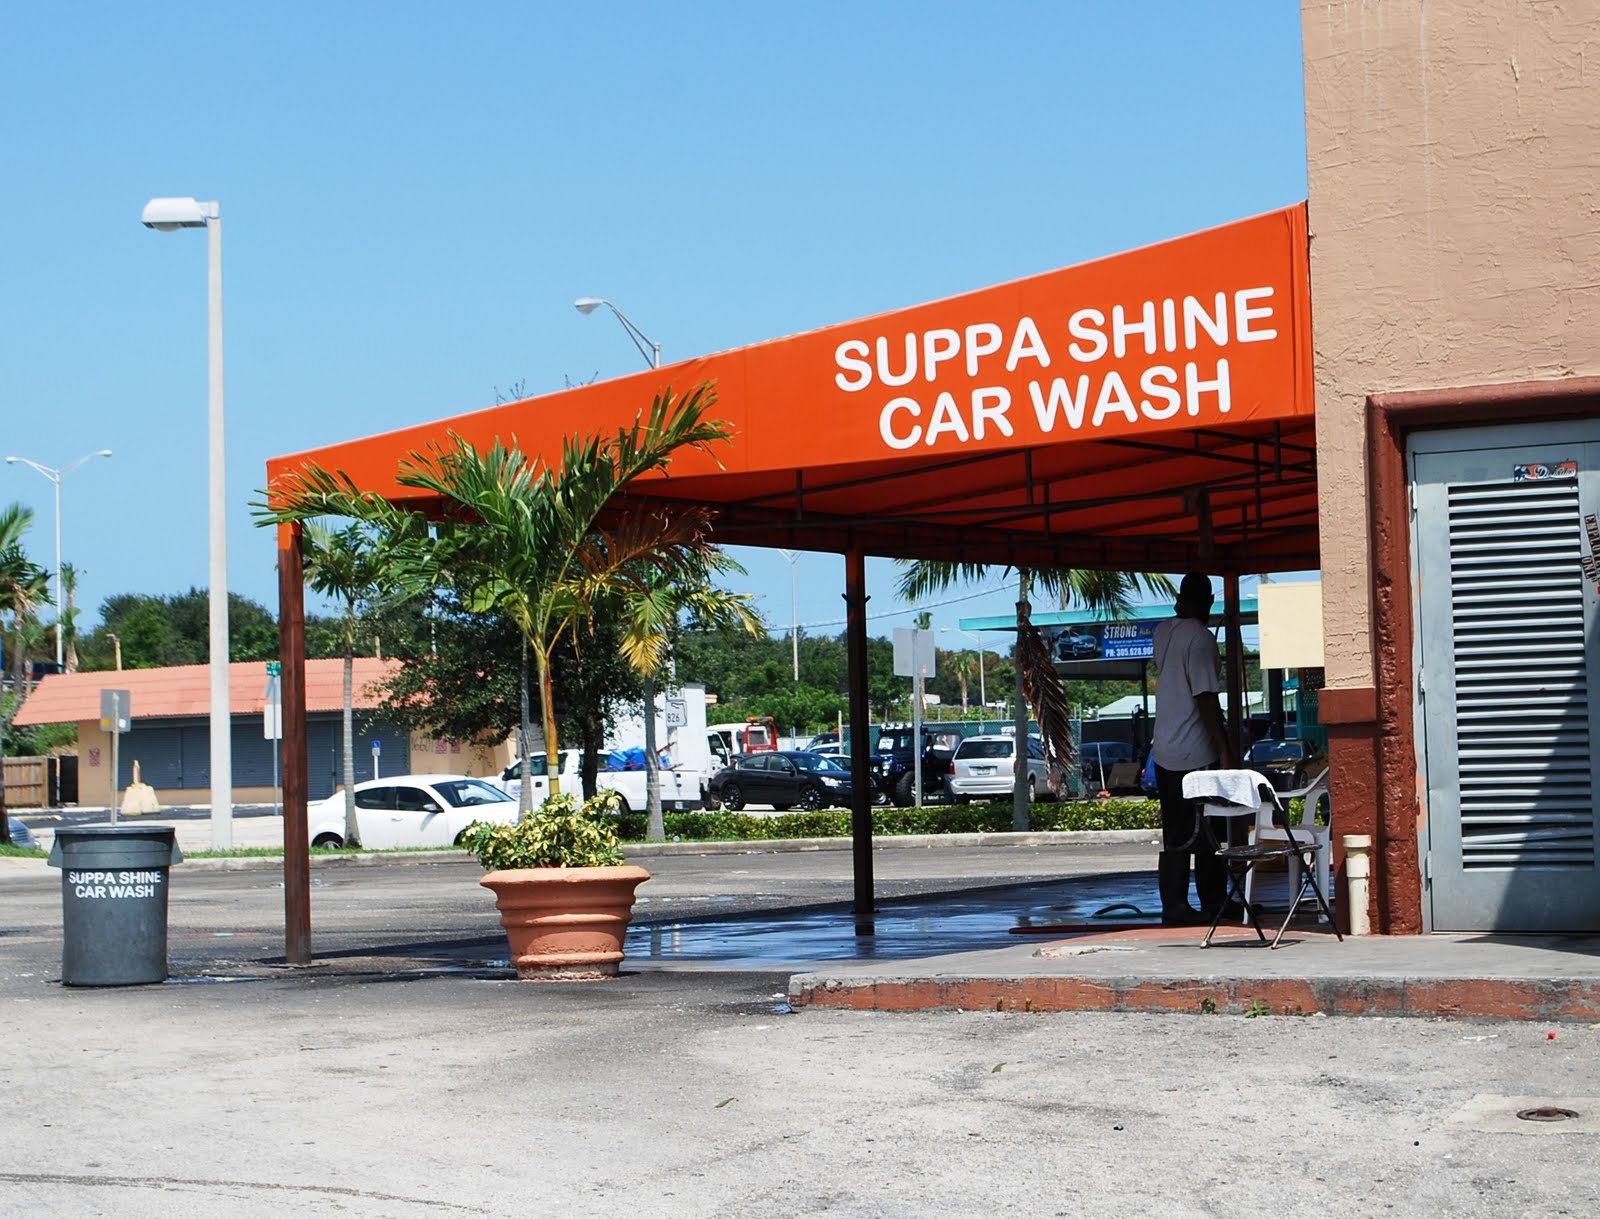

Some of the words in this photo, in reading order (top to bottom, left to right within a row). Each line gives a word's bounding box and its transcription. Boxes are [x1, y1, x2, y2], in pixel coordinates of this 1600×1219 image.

[834, 316, 1051, 392] SUPPA
[1068, 286, 1278, 363] SHINE
[879, 386, 1014, 450] CAR
[1028, 358, 1231, 433] WASH
[1104, 625, 1137, 639] STRONG
[667, 713, 680, 722] 826
[69, 871, 117, 885] SUPPA
[118, 871, 161, 884] SHINE
[75, 885, 107, 899] CAR
[108, 884, 155, 899] WASH
